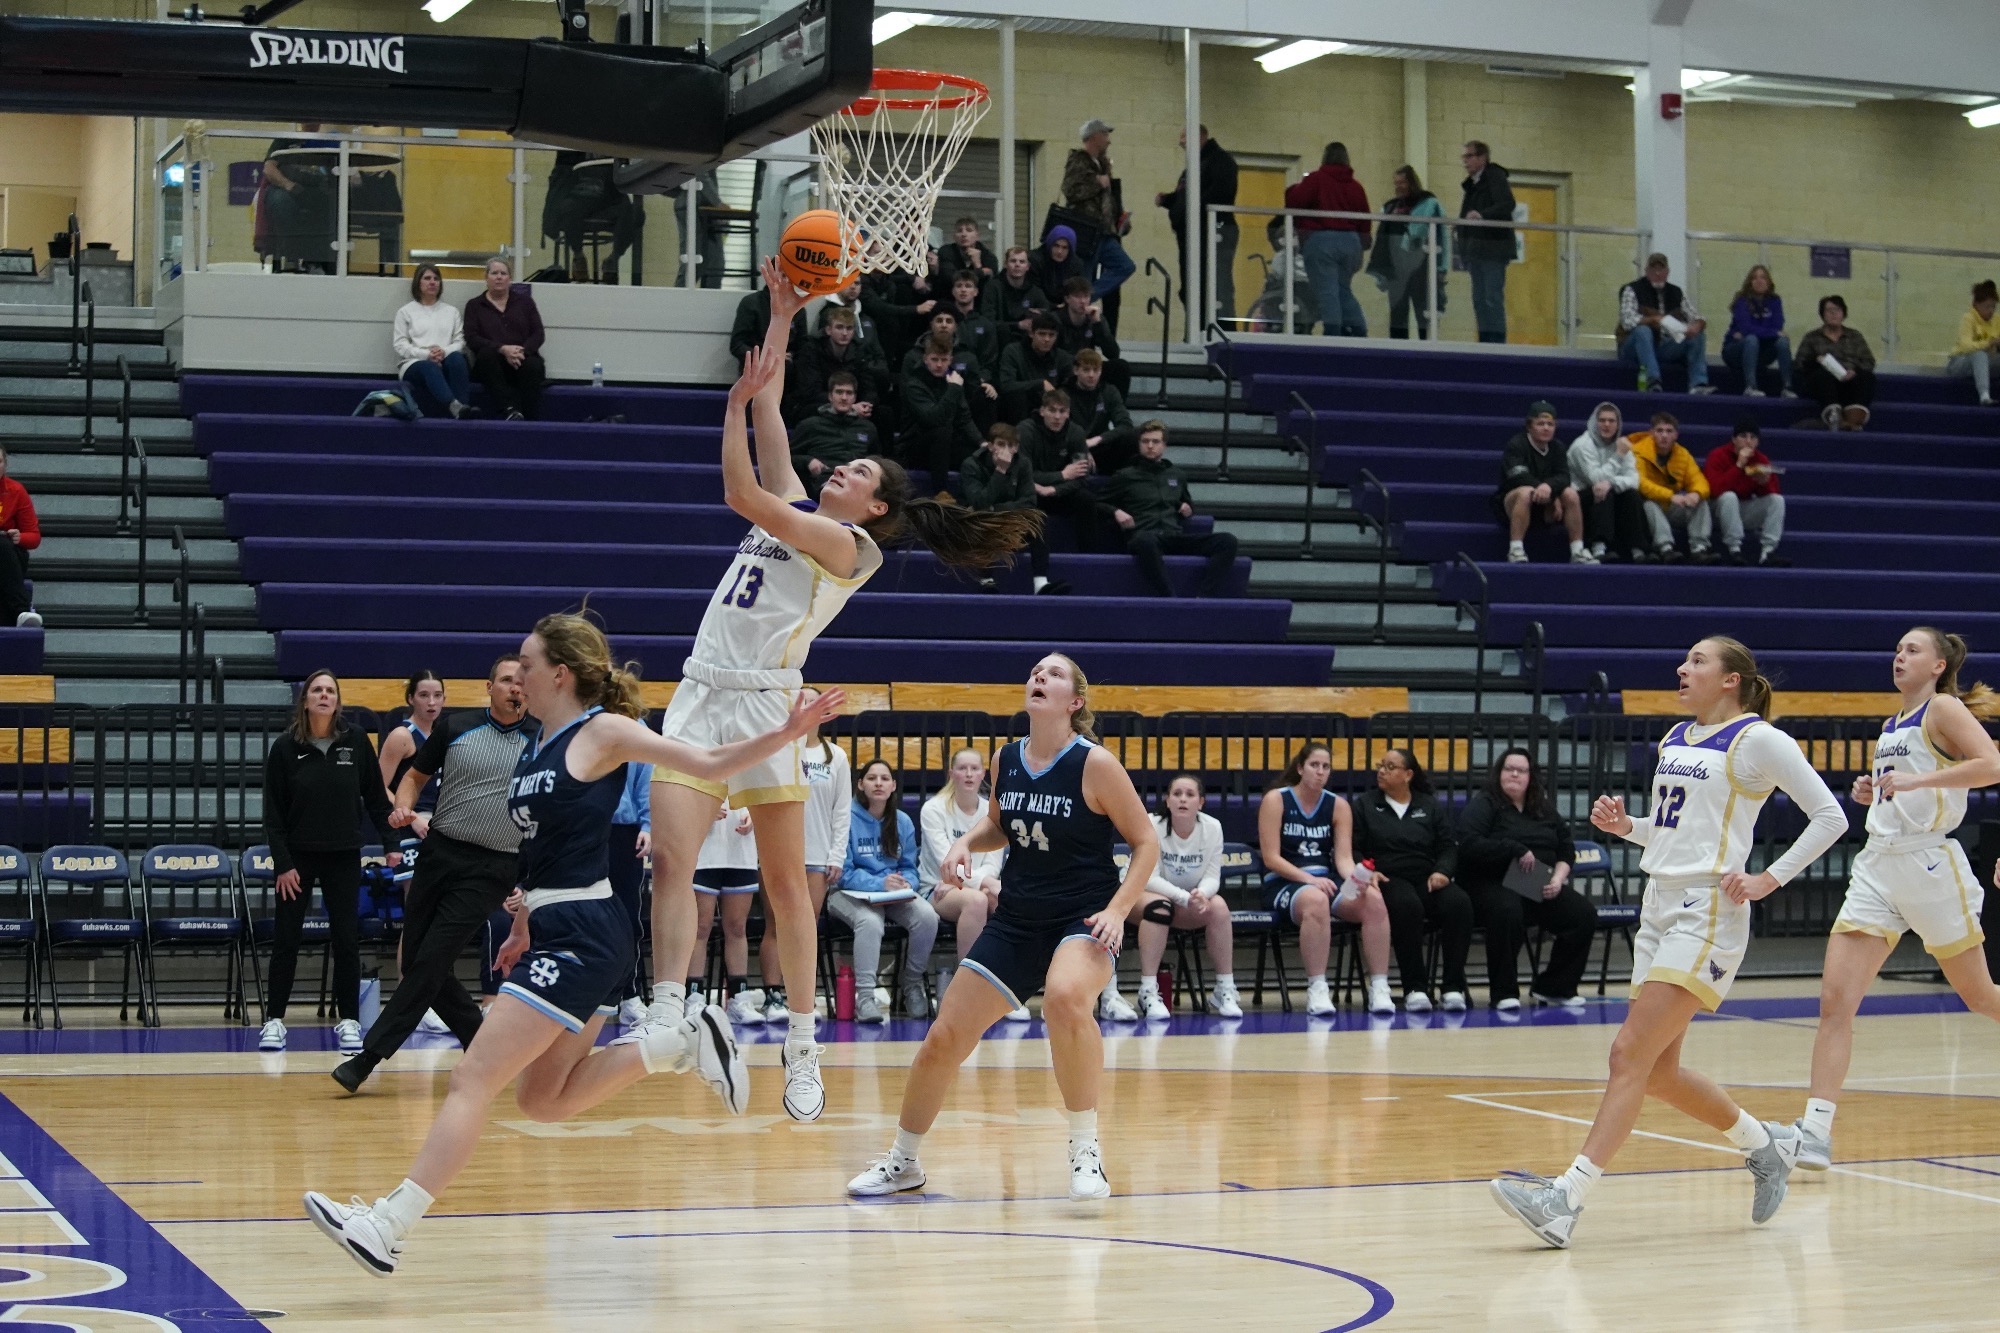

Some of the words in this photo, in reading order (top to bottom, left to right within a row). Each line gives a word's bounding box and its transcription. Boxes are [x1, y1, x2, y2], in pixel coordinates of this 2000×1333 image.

[250, 31, 404, 74] SPALDING
[722, 564, 764, 609] 13
[1027, 793, 1073, 818] MARY'S
[1654, 785, 1686, 829] 12
[1010, 818, 1050, 852] 34
[52, 855, 117, 871] LORAS
[154, 855, 219, 870] LORAS
[82, 922, 130, 931] duhawks.com
[179, 921, 228, 930] duhawks.com
